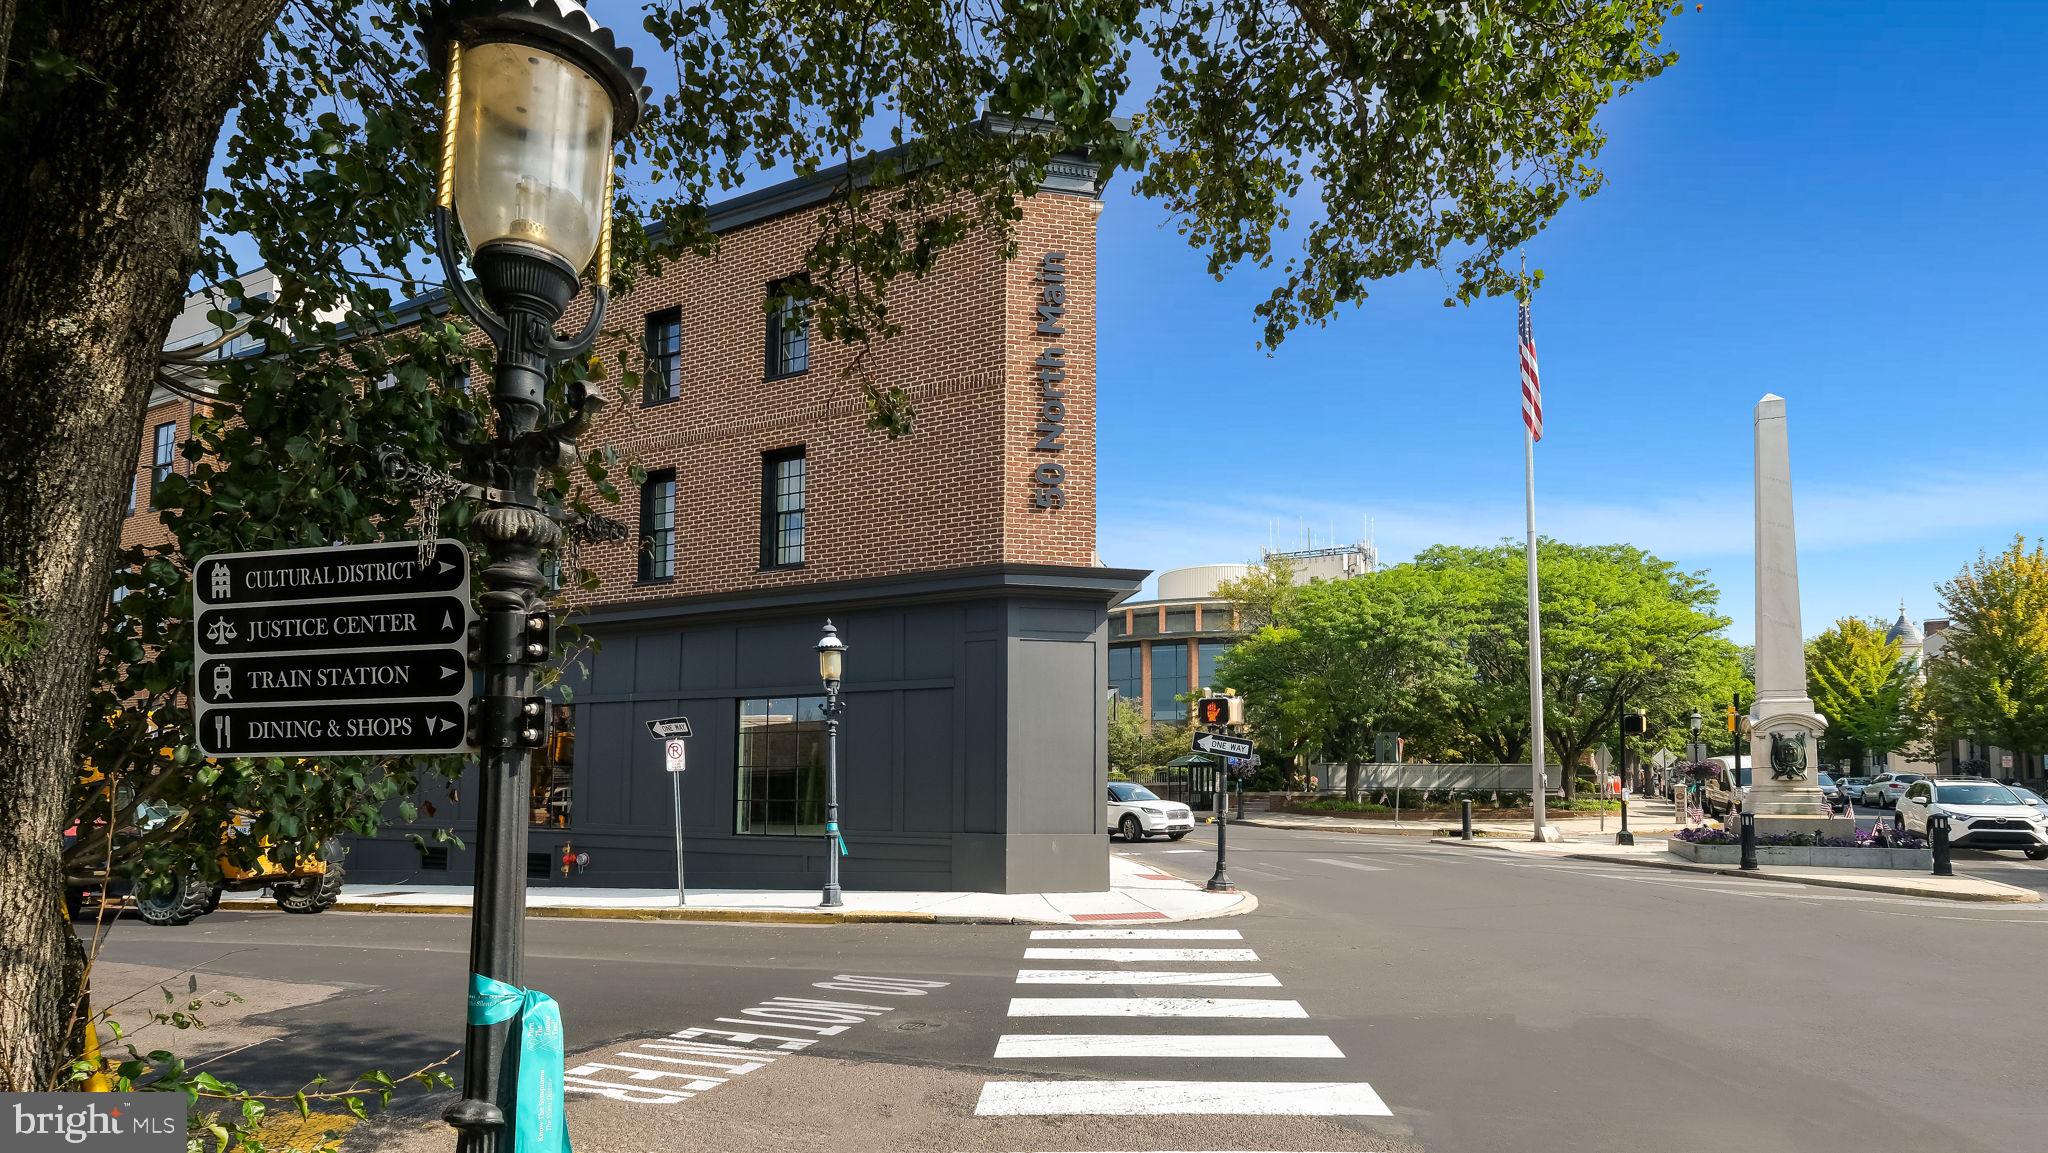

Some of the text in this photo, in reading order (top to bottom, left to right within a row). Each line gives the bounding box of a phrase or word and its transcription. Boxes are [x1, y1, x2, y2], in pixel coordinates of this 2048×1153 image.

[1035, 251, 1066, 510] 50 North Main
[245, 561, 415, 589] CULTURAL DISTRICT
[247, 613, 417, 642] JUSTICE CENTER
[247, 665, 410, 689] TRAIN STATION
[248, 717, 413, 740] DINING & SHOPS
[675, 723, 686, 731] WAY
[1211, 741, 1246, 753] ONE WAY
